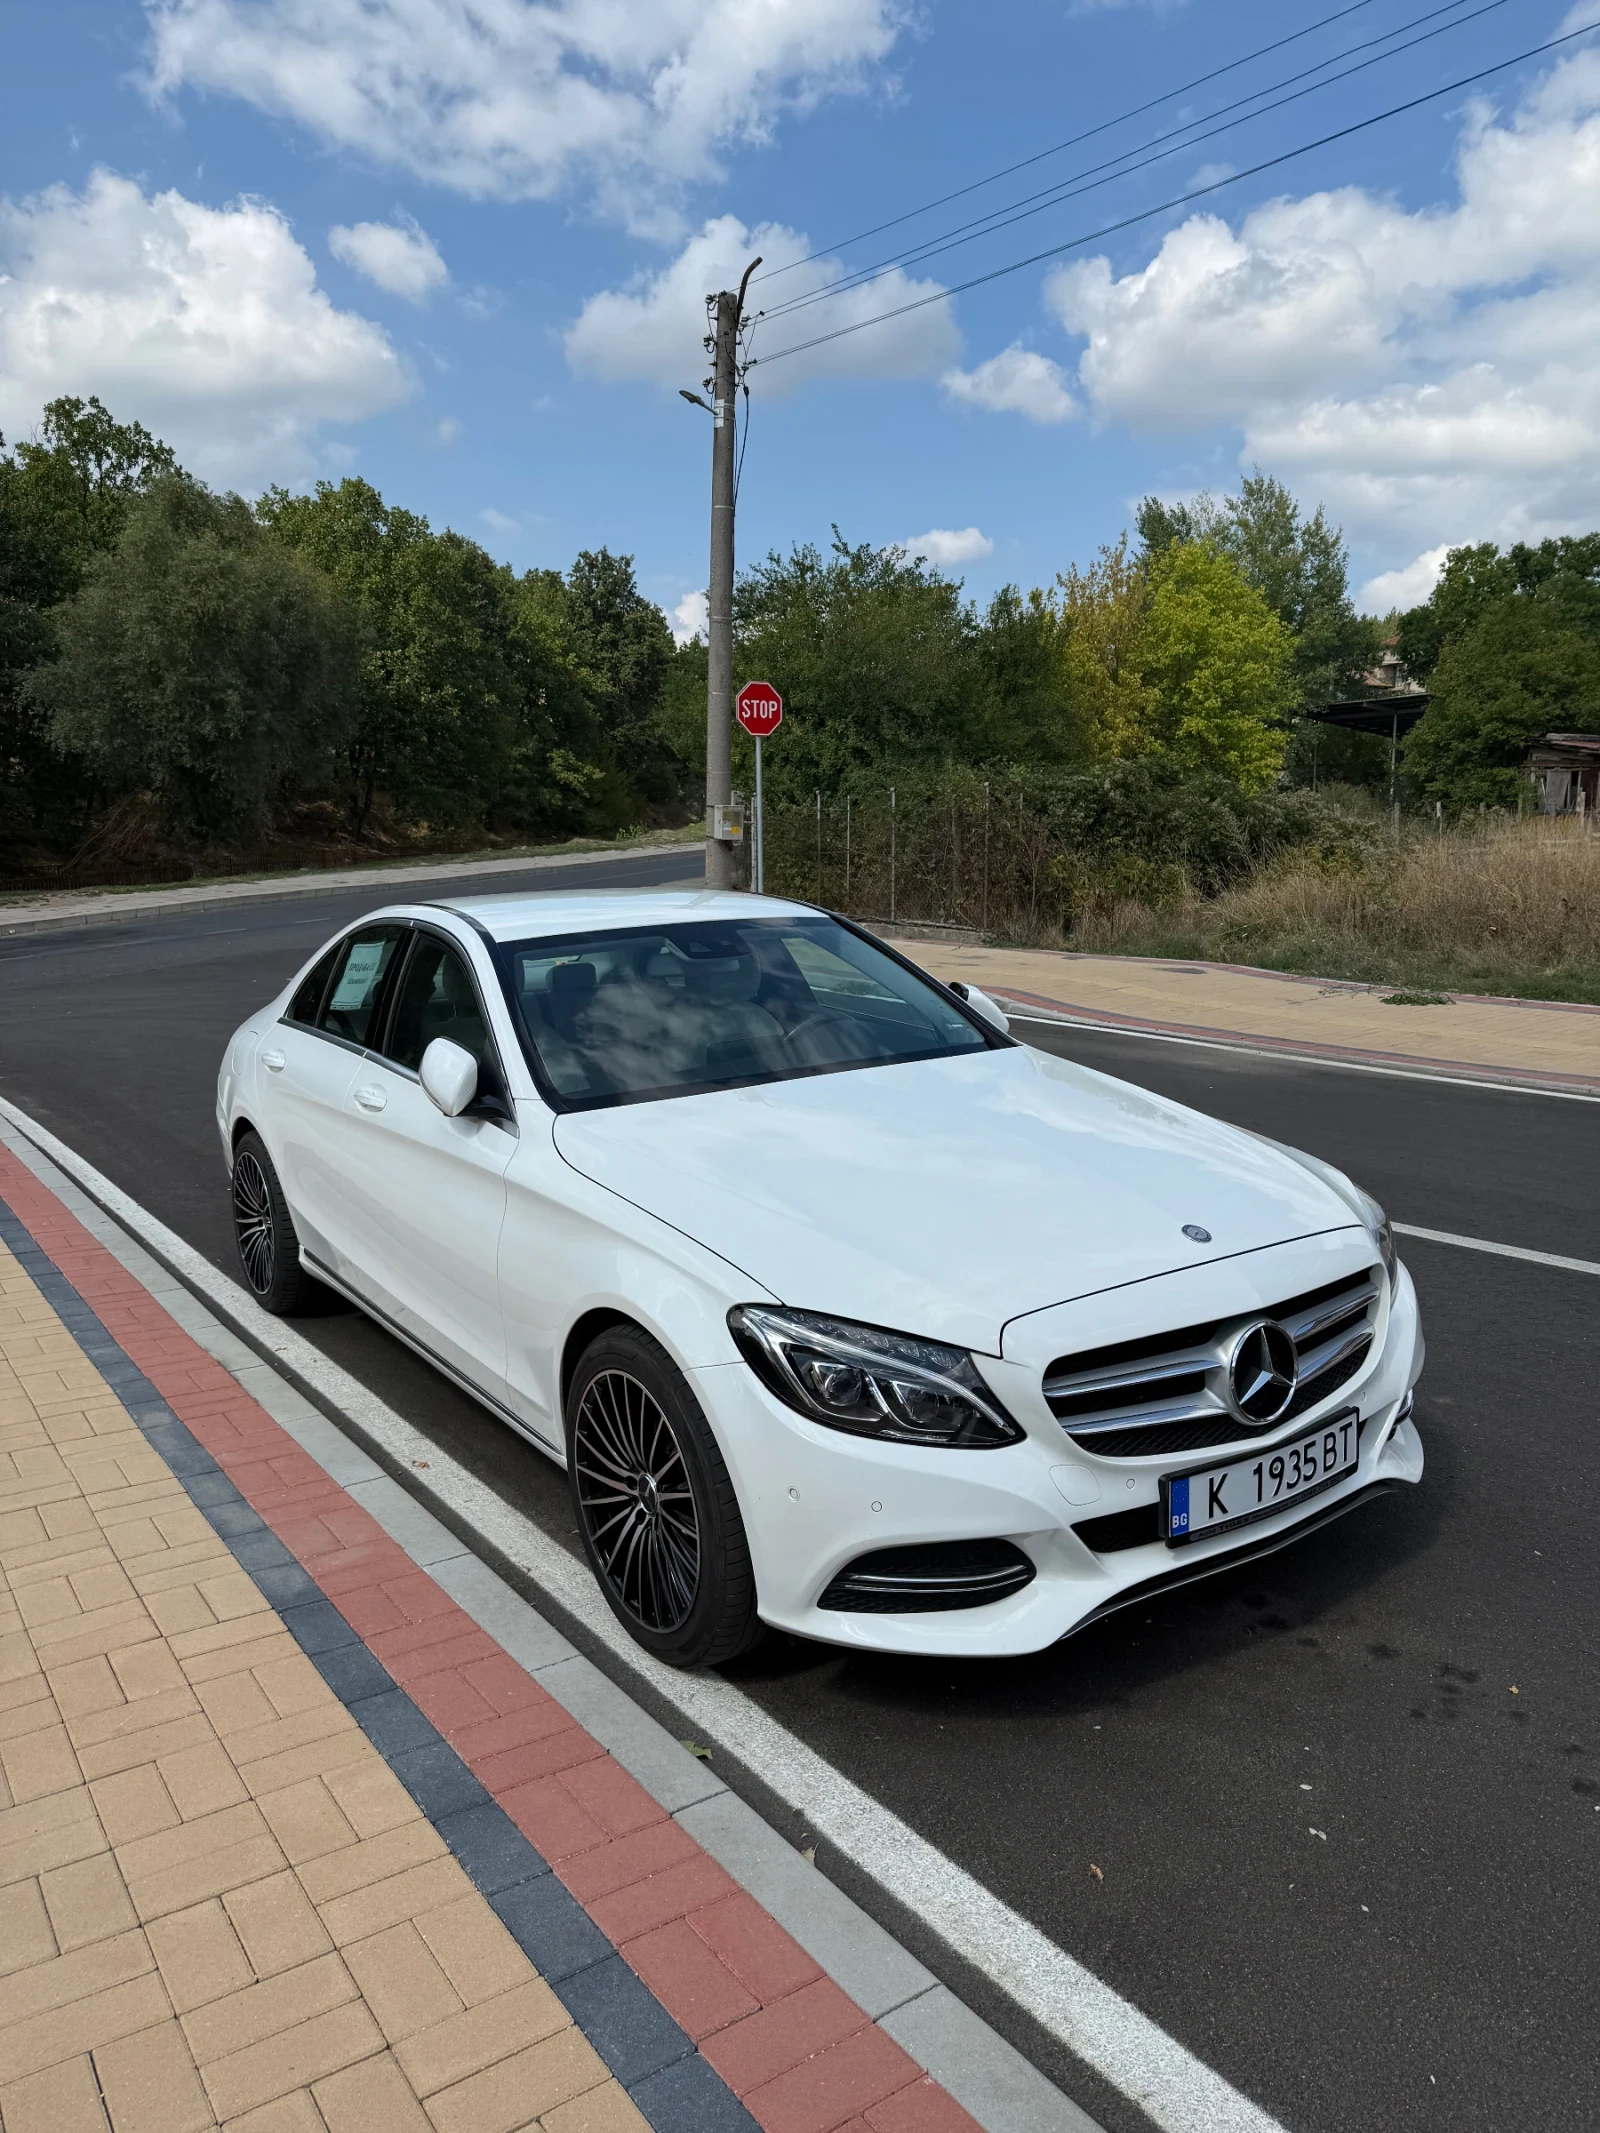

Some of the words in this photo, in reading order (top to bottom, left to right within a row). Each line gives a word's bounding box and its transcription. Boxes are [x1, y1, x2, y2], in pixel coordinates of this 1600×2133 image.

[742, 699, 777, 719] STOP
[1208, 1473, 1229, 1518] K
[1253, 1440, 1317, 1503] 1935
[1323, 1421, 1352, 1473] BT
[1172, 1513, 1188, 1528] BG
